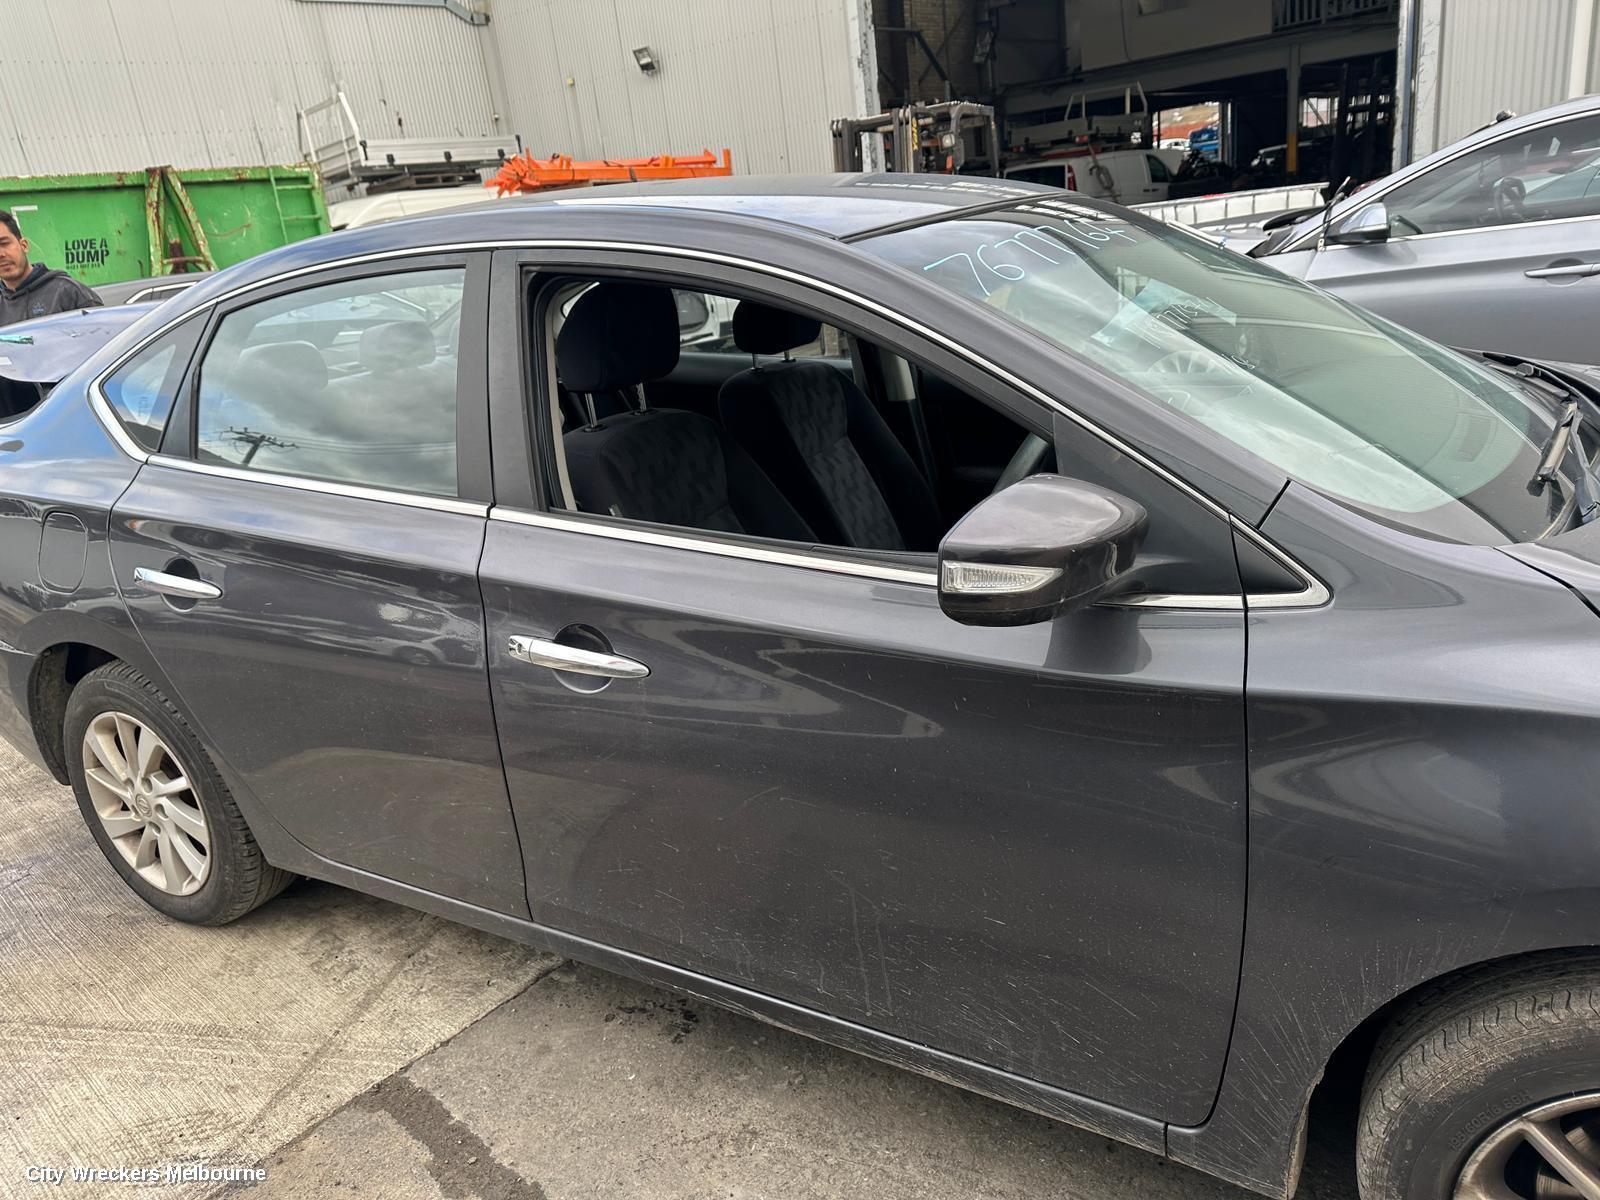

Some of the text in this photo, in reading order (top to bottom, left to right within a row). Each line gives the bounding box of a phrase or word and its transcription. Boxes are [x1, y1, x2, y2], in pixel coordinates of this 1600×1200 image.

[64, 237, 108, 251] LOVE A
[65, 249, 110, 266] DUMP
